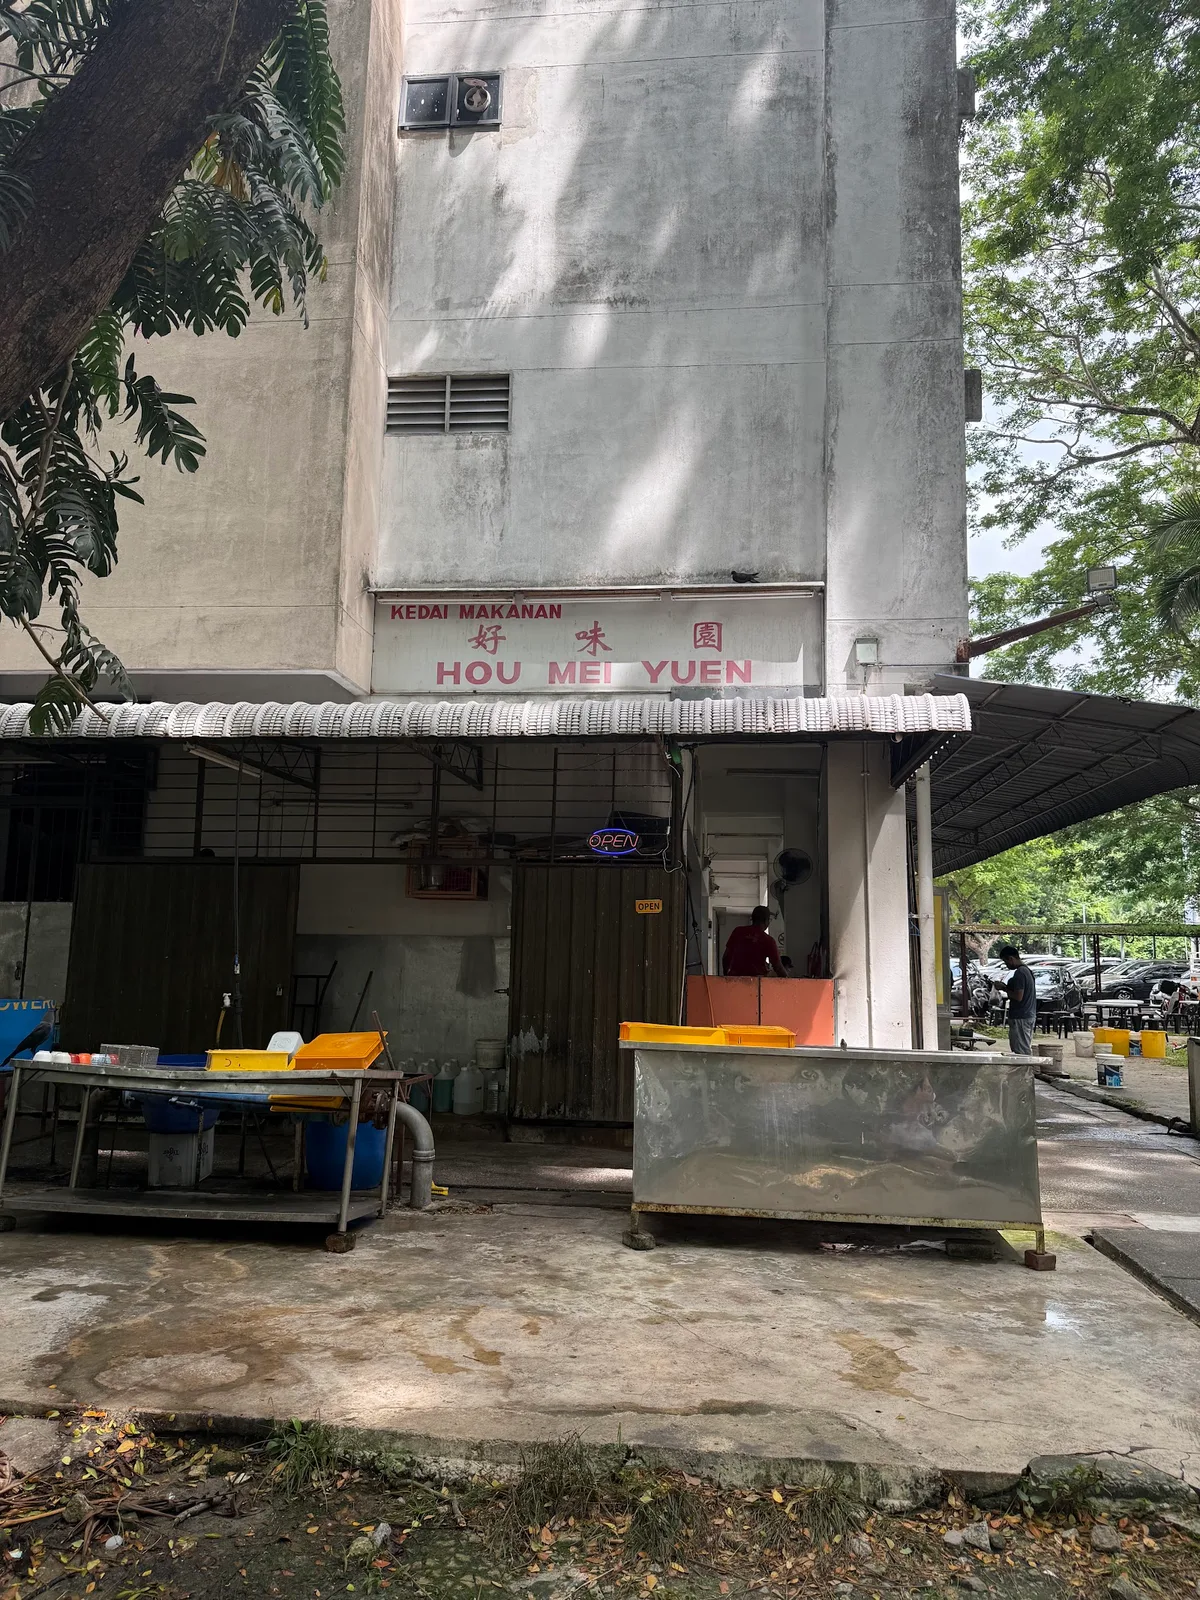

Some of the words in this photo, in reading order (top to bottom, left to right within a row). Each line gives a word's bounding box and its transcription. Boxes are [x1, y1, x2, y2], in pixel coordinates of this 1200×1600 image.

[391, 604, 448, 620] KEDAI
[459, 604, 562, 619] MAKANAN
[468, 620, 723, 656] 好味園
[436, 661, 521, 685] HOU
[548, 661, 612, 684] MEI
[641, 660, 752, 684] YUEN
[589, 834, 639, 848] OPEN
[638, 901, 660, 911] OPEN
